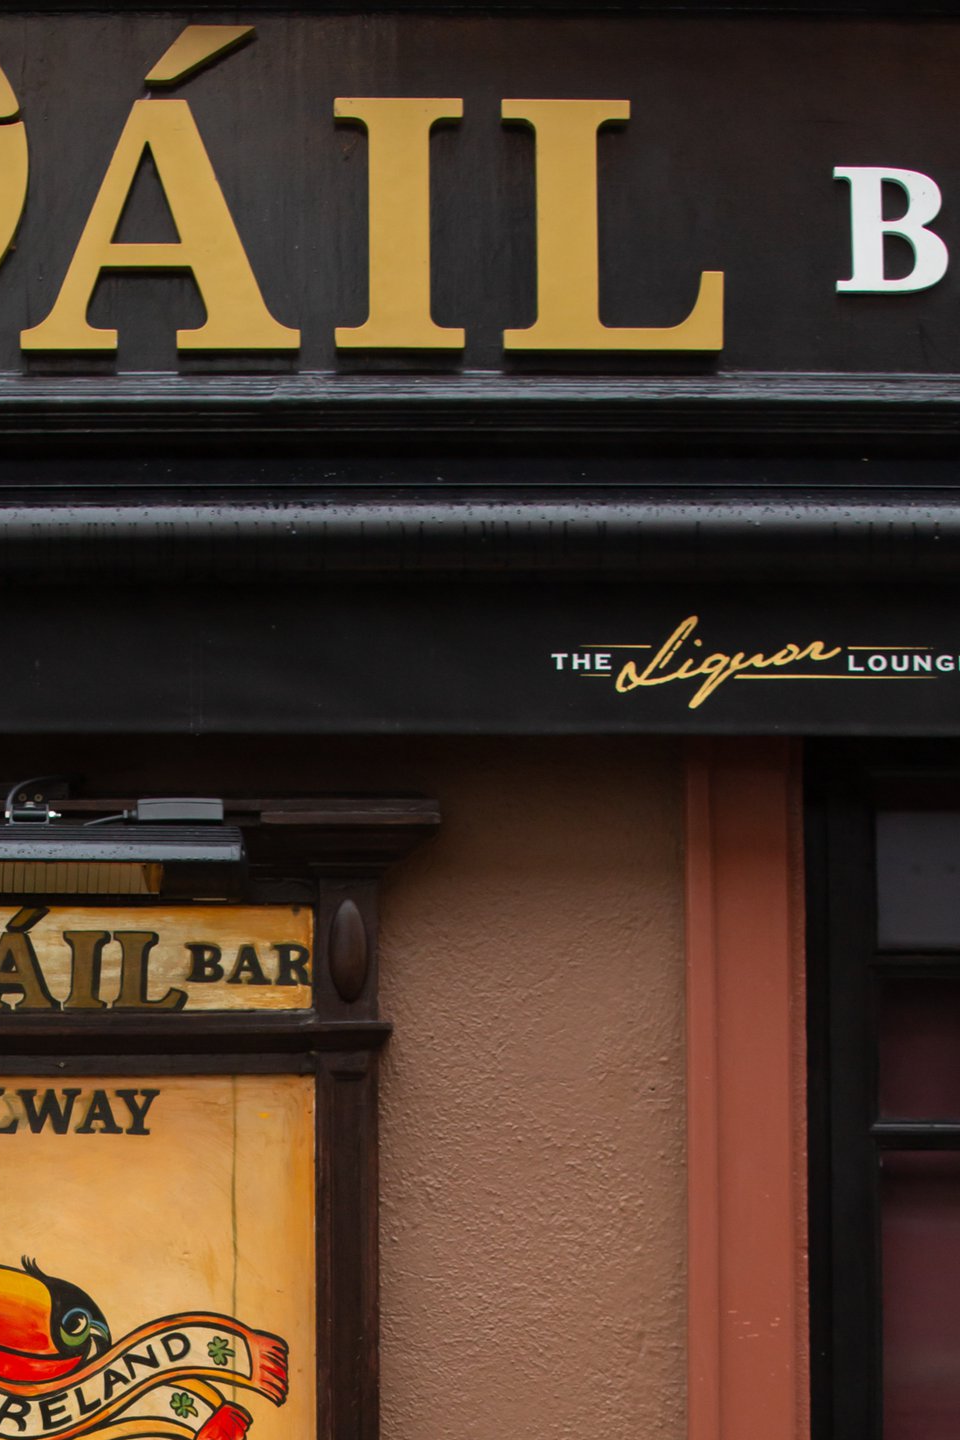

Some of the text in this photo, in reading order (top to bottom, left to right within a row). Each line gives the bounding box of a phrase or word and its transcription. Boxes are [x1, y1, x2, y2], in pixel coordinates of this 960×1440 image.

[833, 166, 949, 294] B
[551, 615, 960, 709] THE Liquor LOUNG
[184, 941, 311, 986] BAR
